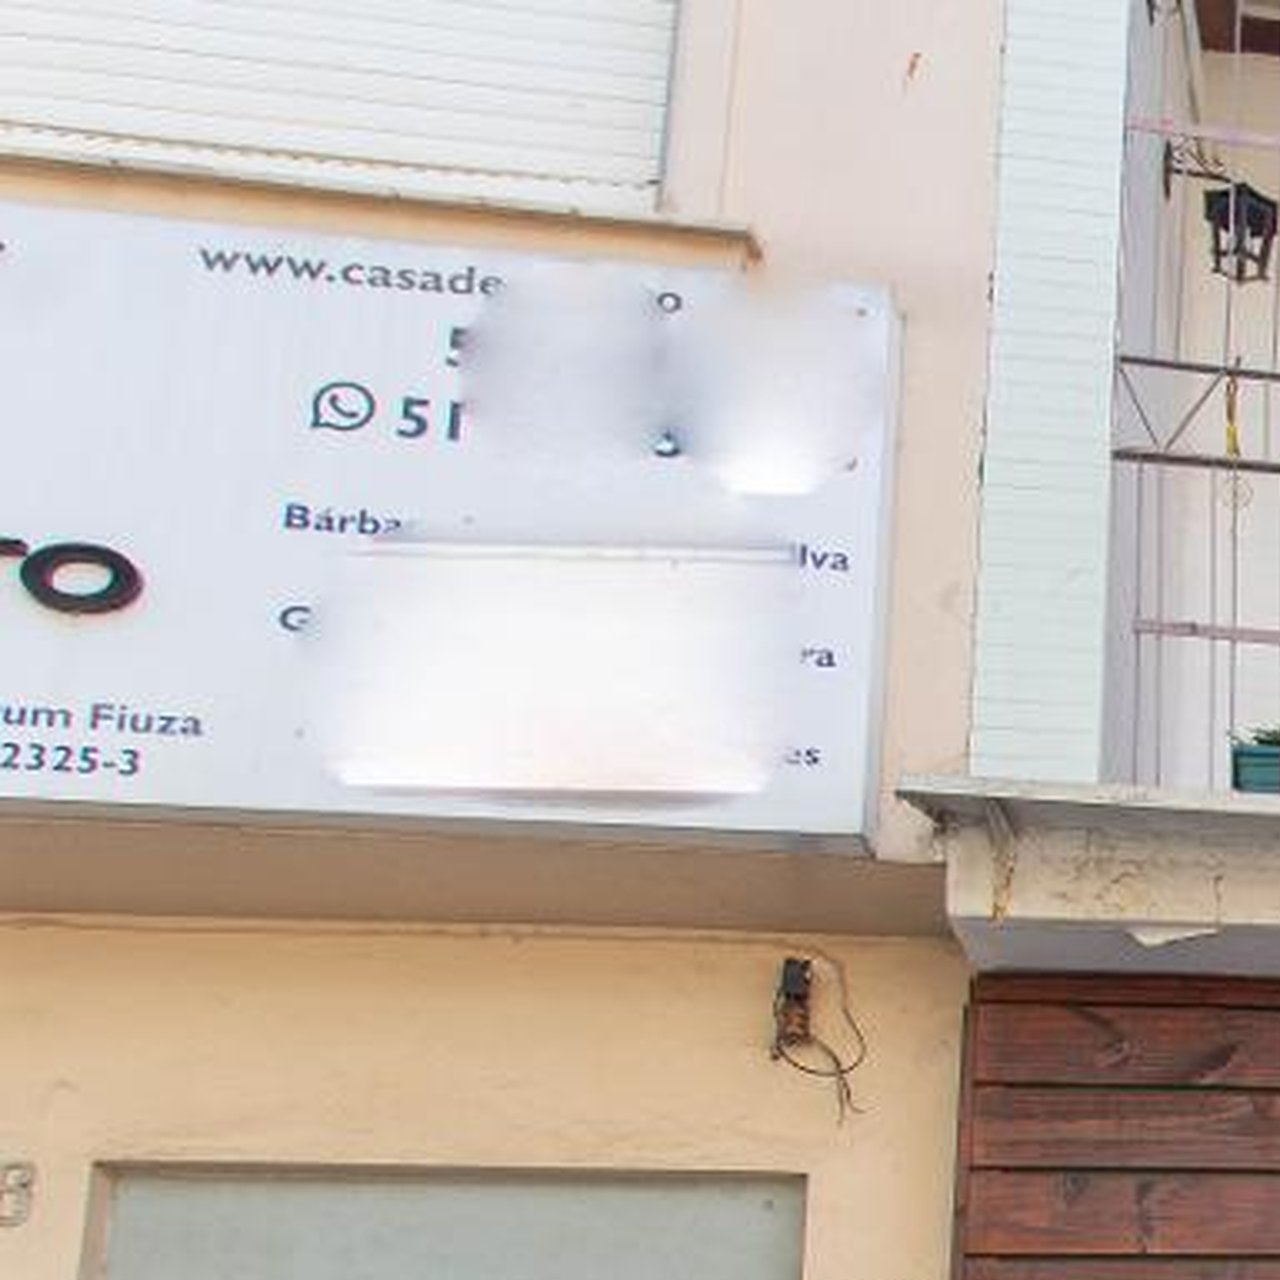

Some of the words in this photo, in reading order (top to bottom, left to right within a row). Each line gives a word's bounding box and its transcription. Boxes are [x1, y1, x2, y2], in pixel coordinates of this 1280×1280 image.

[199, 249, 508, 296] www.casade
[798, 543, 851, 573] lva
[89, 704, 203, 736] Fiuza
[1, 742, 141, 777] 2325-3
